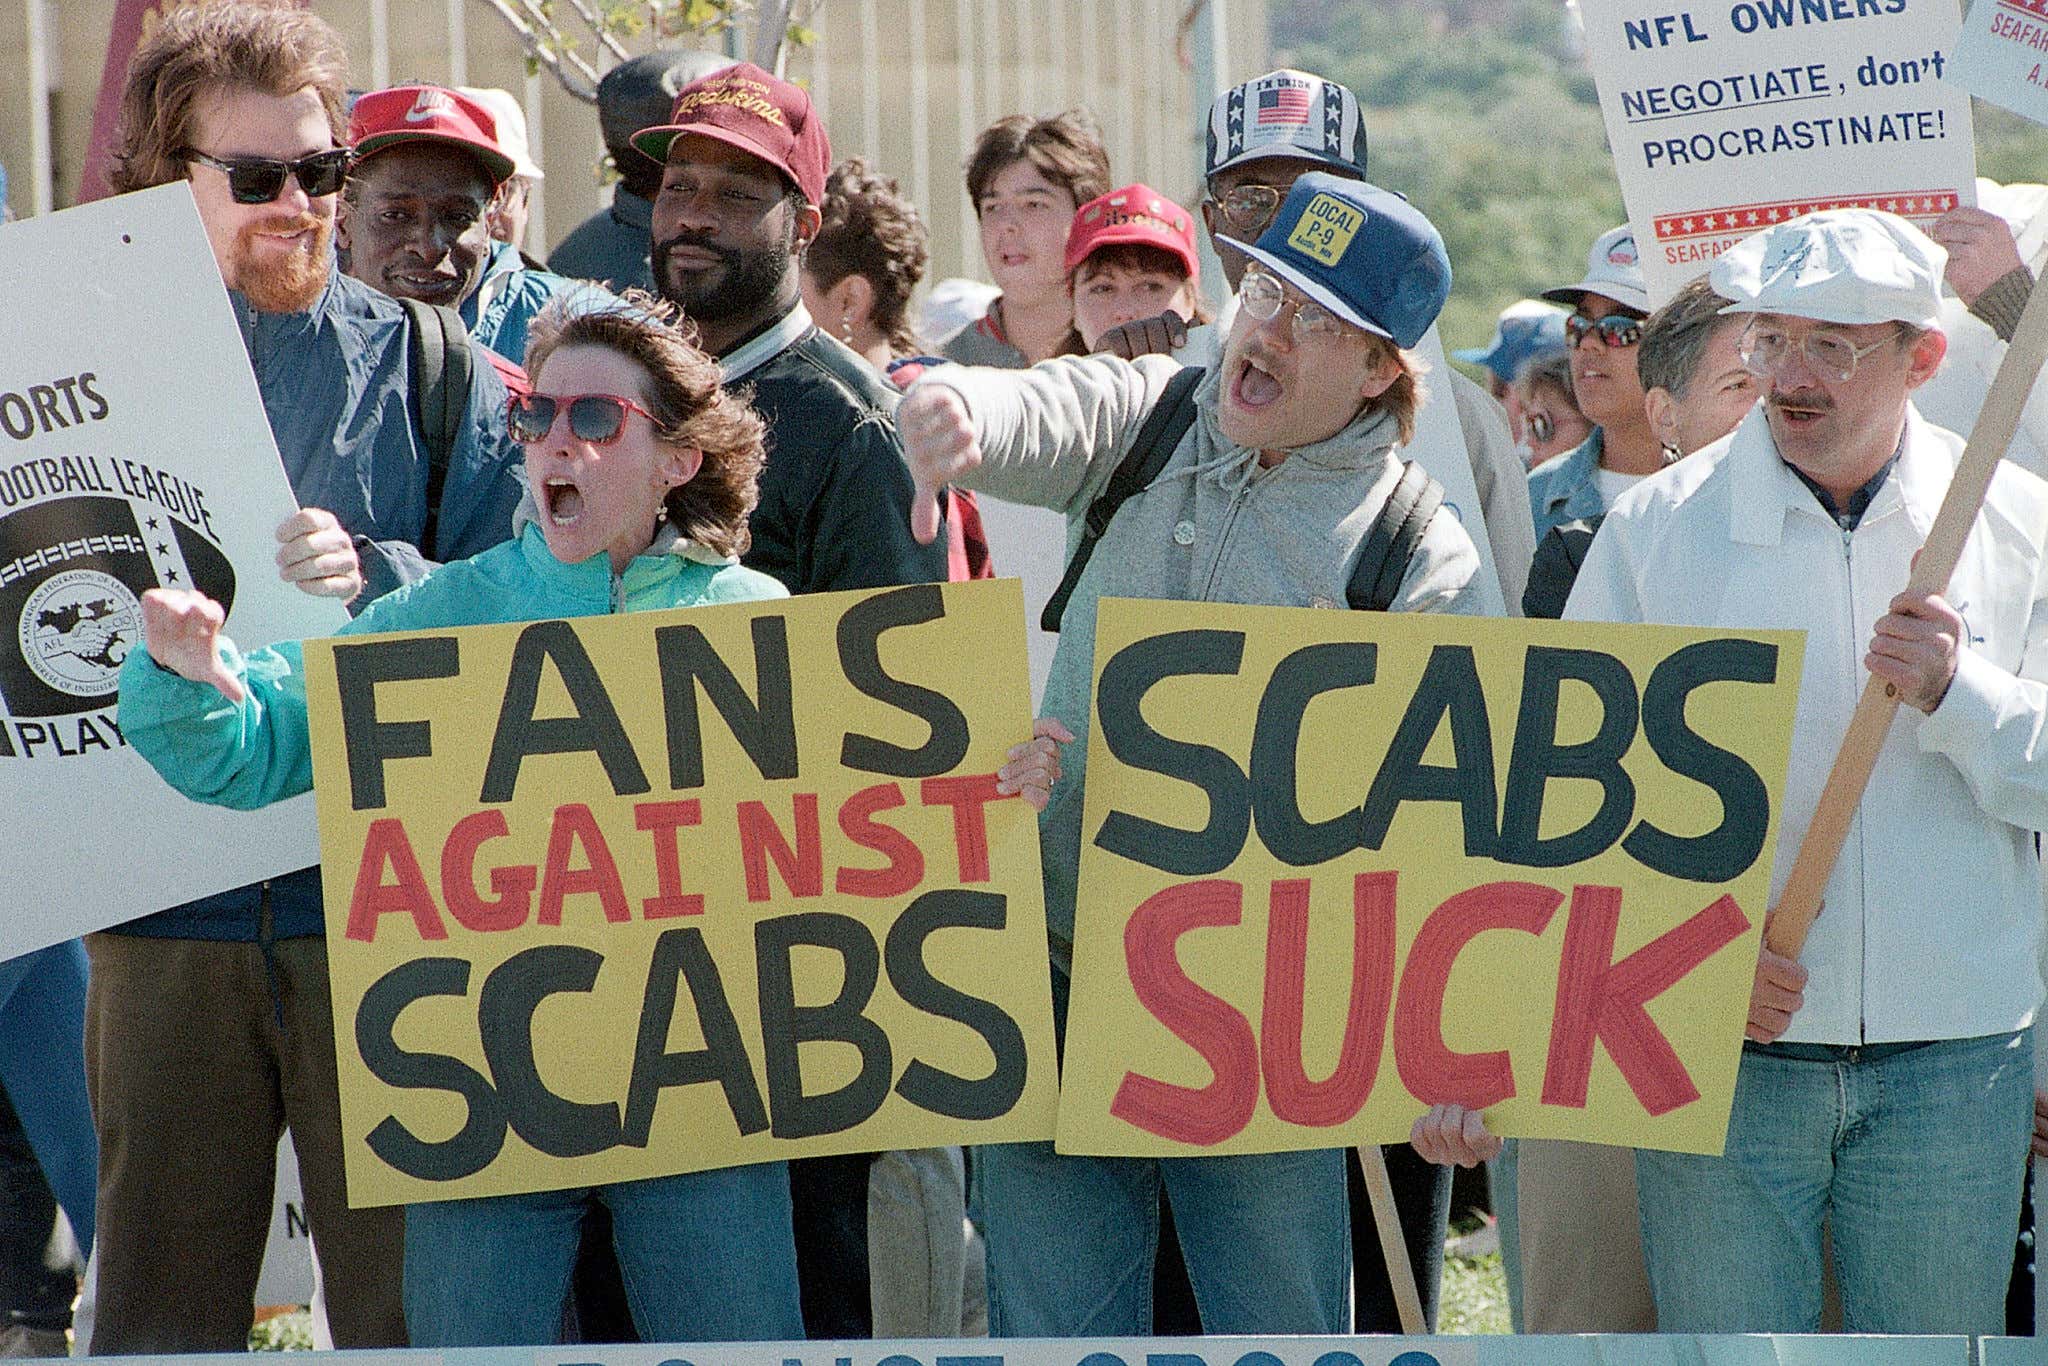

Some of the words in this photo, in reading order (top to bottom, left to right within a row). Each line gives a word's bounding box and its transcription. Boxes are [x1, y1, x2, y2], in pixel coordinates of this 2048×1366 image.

[1624, 13, 1708, 50] NFL
[1857, 51, 1945, 87] don't
[416, 89, 455, 109] NIKE
[674, 88, 784, 127] Redskins
[1643, 110, 1945, 169] PROCRASTINATE!
[1306, 220, 1335, 246] P-9
[1309, 198, 1355, 234] LOCAL
[0, 372, 109, 440] ORTS
[110, 457, 221, 545] LEAGUE
[43, 638, 65, 652] AFL
[333, 584, 970, 811] FANS
[1093, 629, 1780, 883] SCABS
[345, 772, 1023, 943] AGAINST
[355, 889, 1028, 1182] SCABS
[1109, 871, 1752, 1147] SUCK
